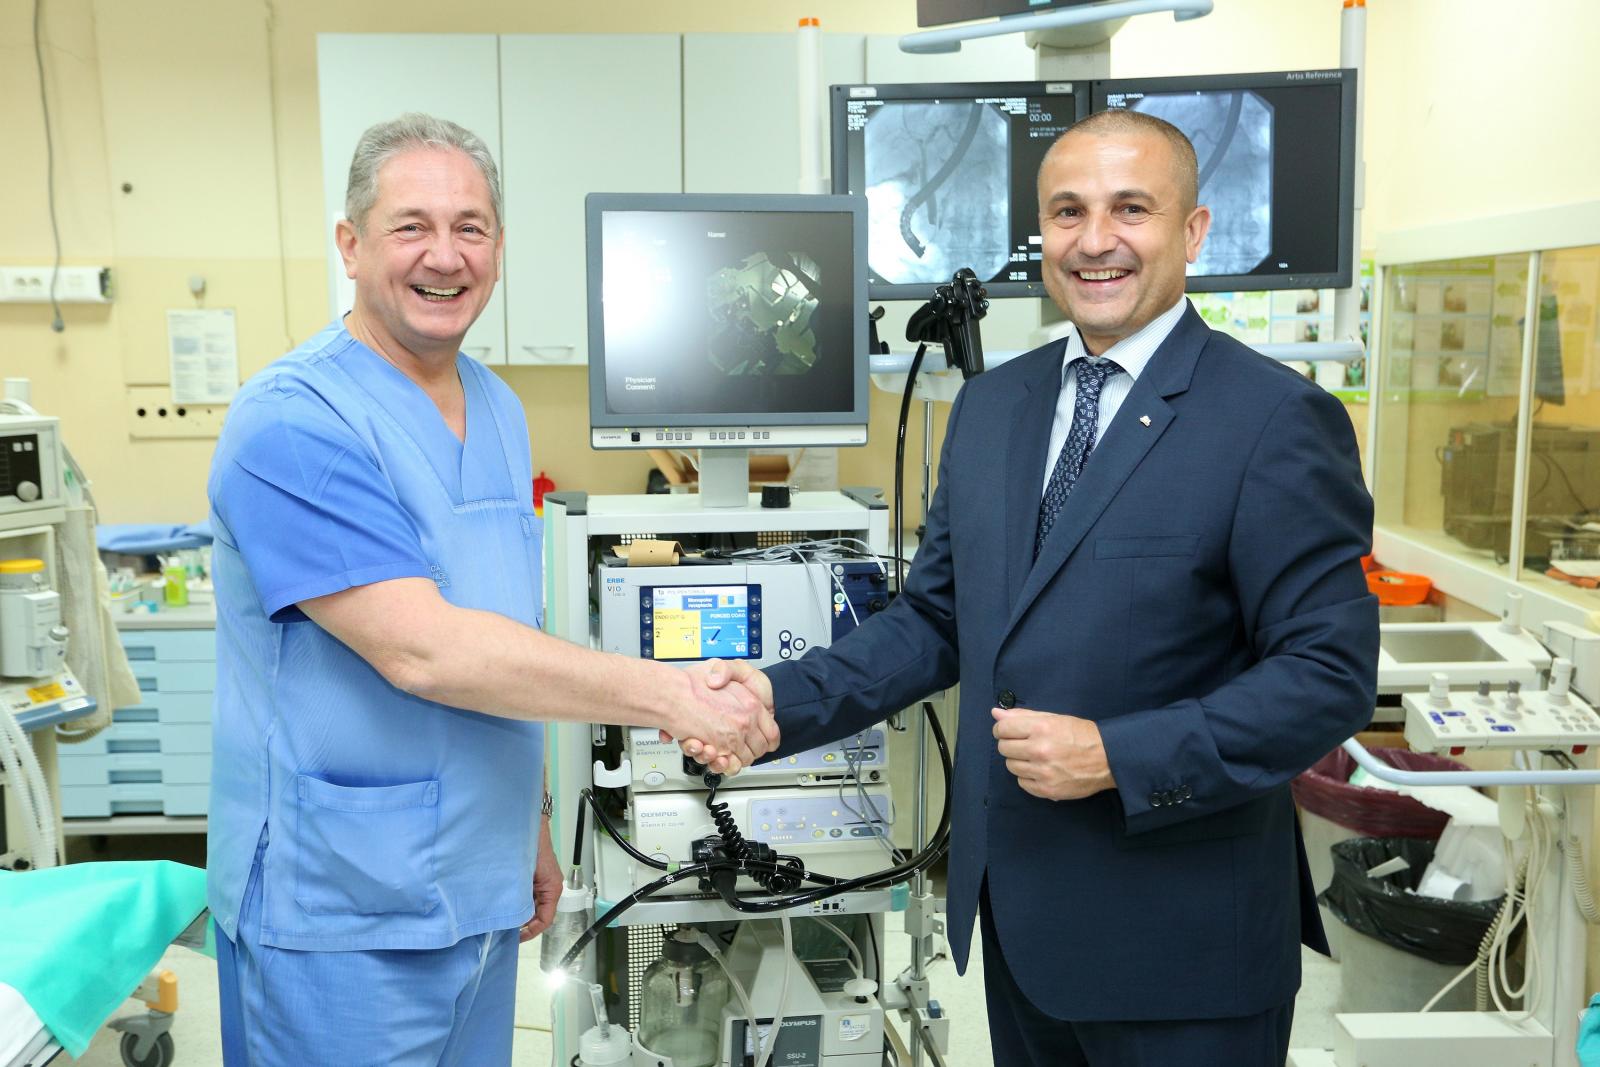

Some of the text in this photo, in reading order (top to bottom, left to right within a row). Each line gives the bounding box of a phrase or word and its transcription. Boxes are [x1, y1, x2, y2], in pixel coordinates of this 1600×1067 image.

[1305, 71, 1342, 79] Reference
[1029, 113, 1052, 122] 00:00
[786, 1052, 806, 1060] SSU-2
